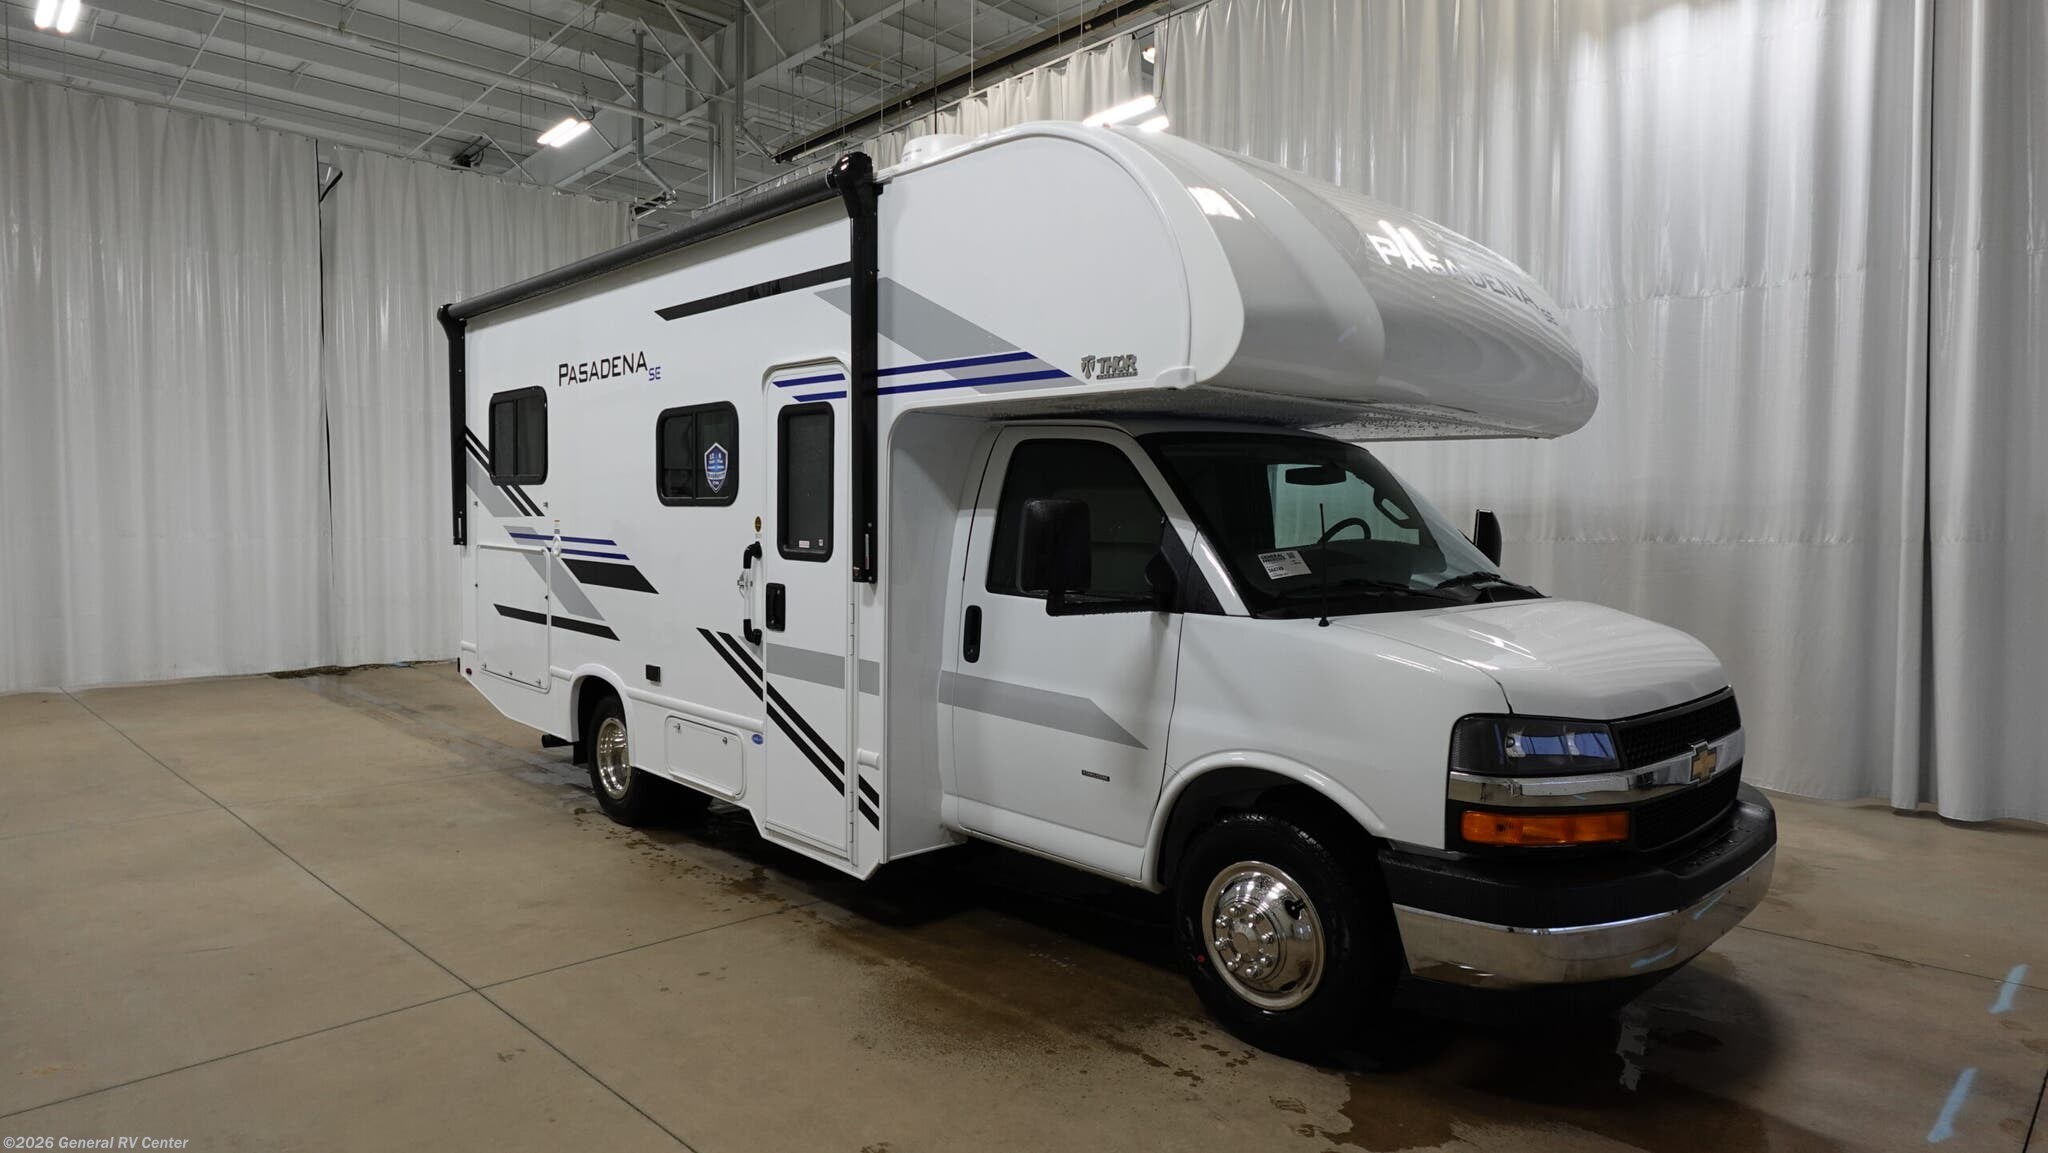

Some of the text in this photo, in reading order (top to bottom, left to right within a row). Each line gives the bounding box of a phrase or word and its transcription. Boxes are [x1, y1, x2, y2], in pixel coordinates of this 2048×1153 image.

[558, 351, 661, 387] PASADENA SE
[1096, 354, 1138, 374] THOR
